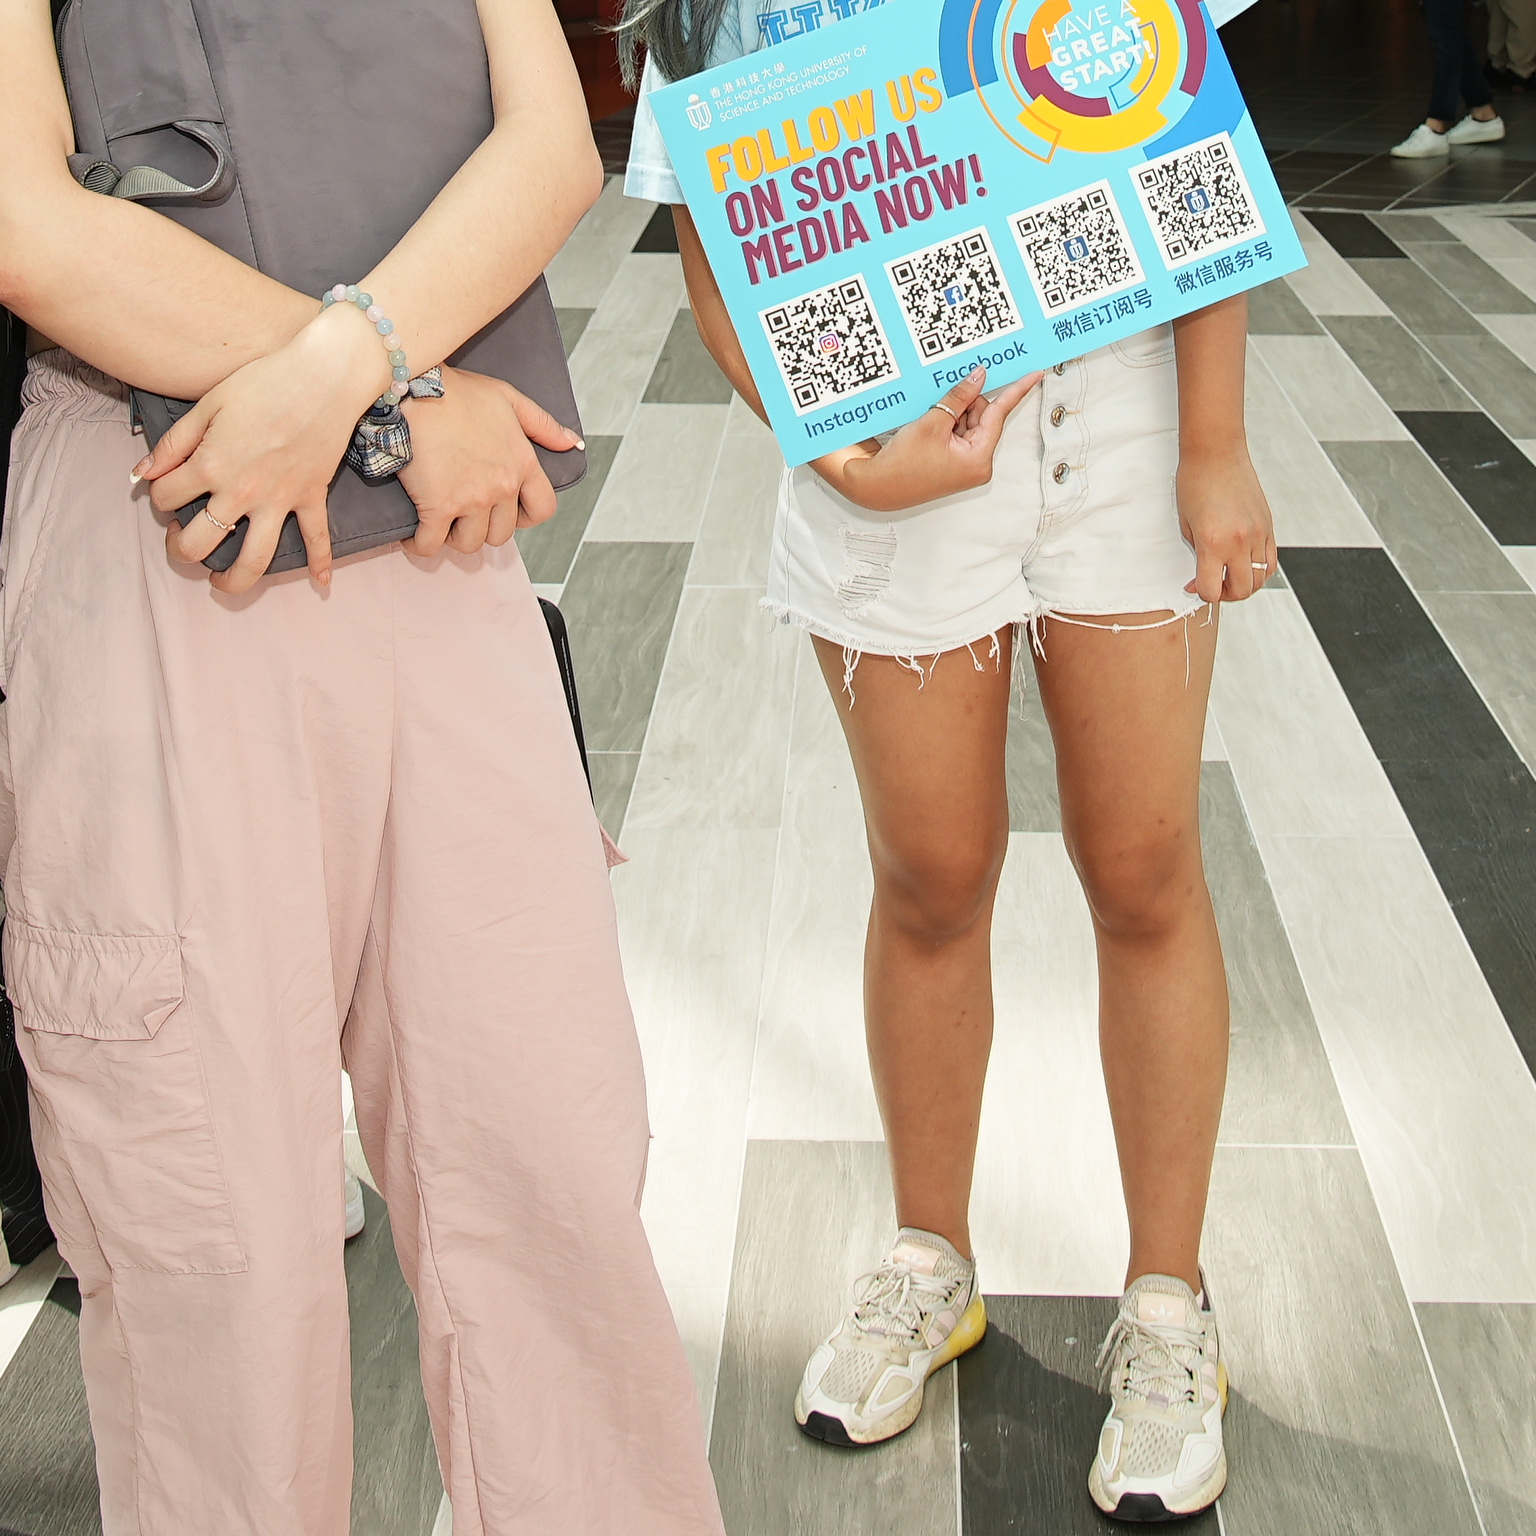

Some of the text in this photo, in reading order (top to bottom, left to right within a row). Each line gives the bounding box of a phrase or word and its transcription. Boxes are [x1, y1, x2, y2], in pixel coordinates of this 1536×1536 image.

[1041, 4, 1112, 46] HAVE
[1051, 16, 1142, 67] GREAT
[709, 62, 787, 99] 香港科技大學
[714, 44, 868, 111] THE HONG KONG UNIVERSITY OF
[1059, 39, 1155, 91] START!
[719, 65, 851, 123] SCIENCE AND TECHNOLOGY
[705, 67, 944, 193] FOLLOW US
[724, 124, 939, 237] ON SOCIAL
[740, 154, 988, 286] MEDIA NOW!
[1172, 240, 1274, 295] 微信服务号
[1052, 287, 1155, 343] 微信订阅号
[931, 338, 1029, 390] Facebook
[803, 385, 907, 441] Instagram
